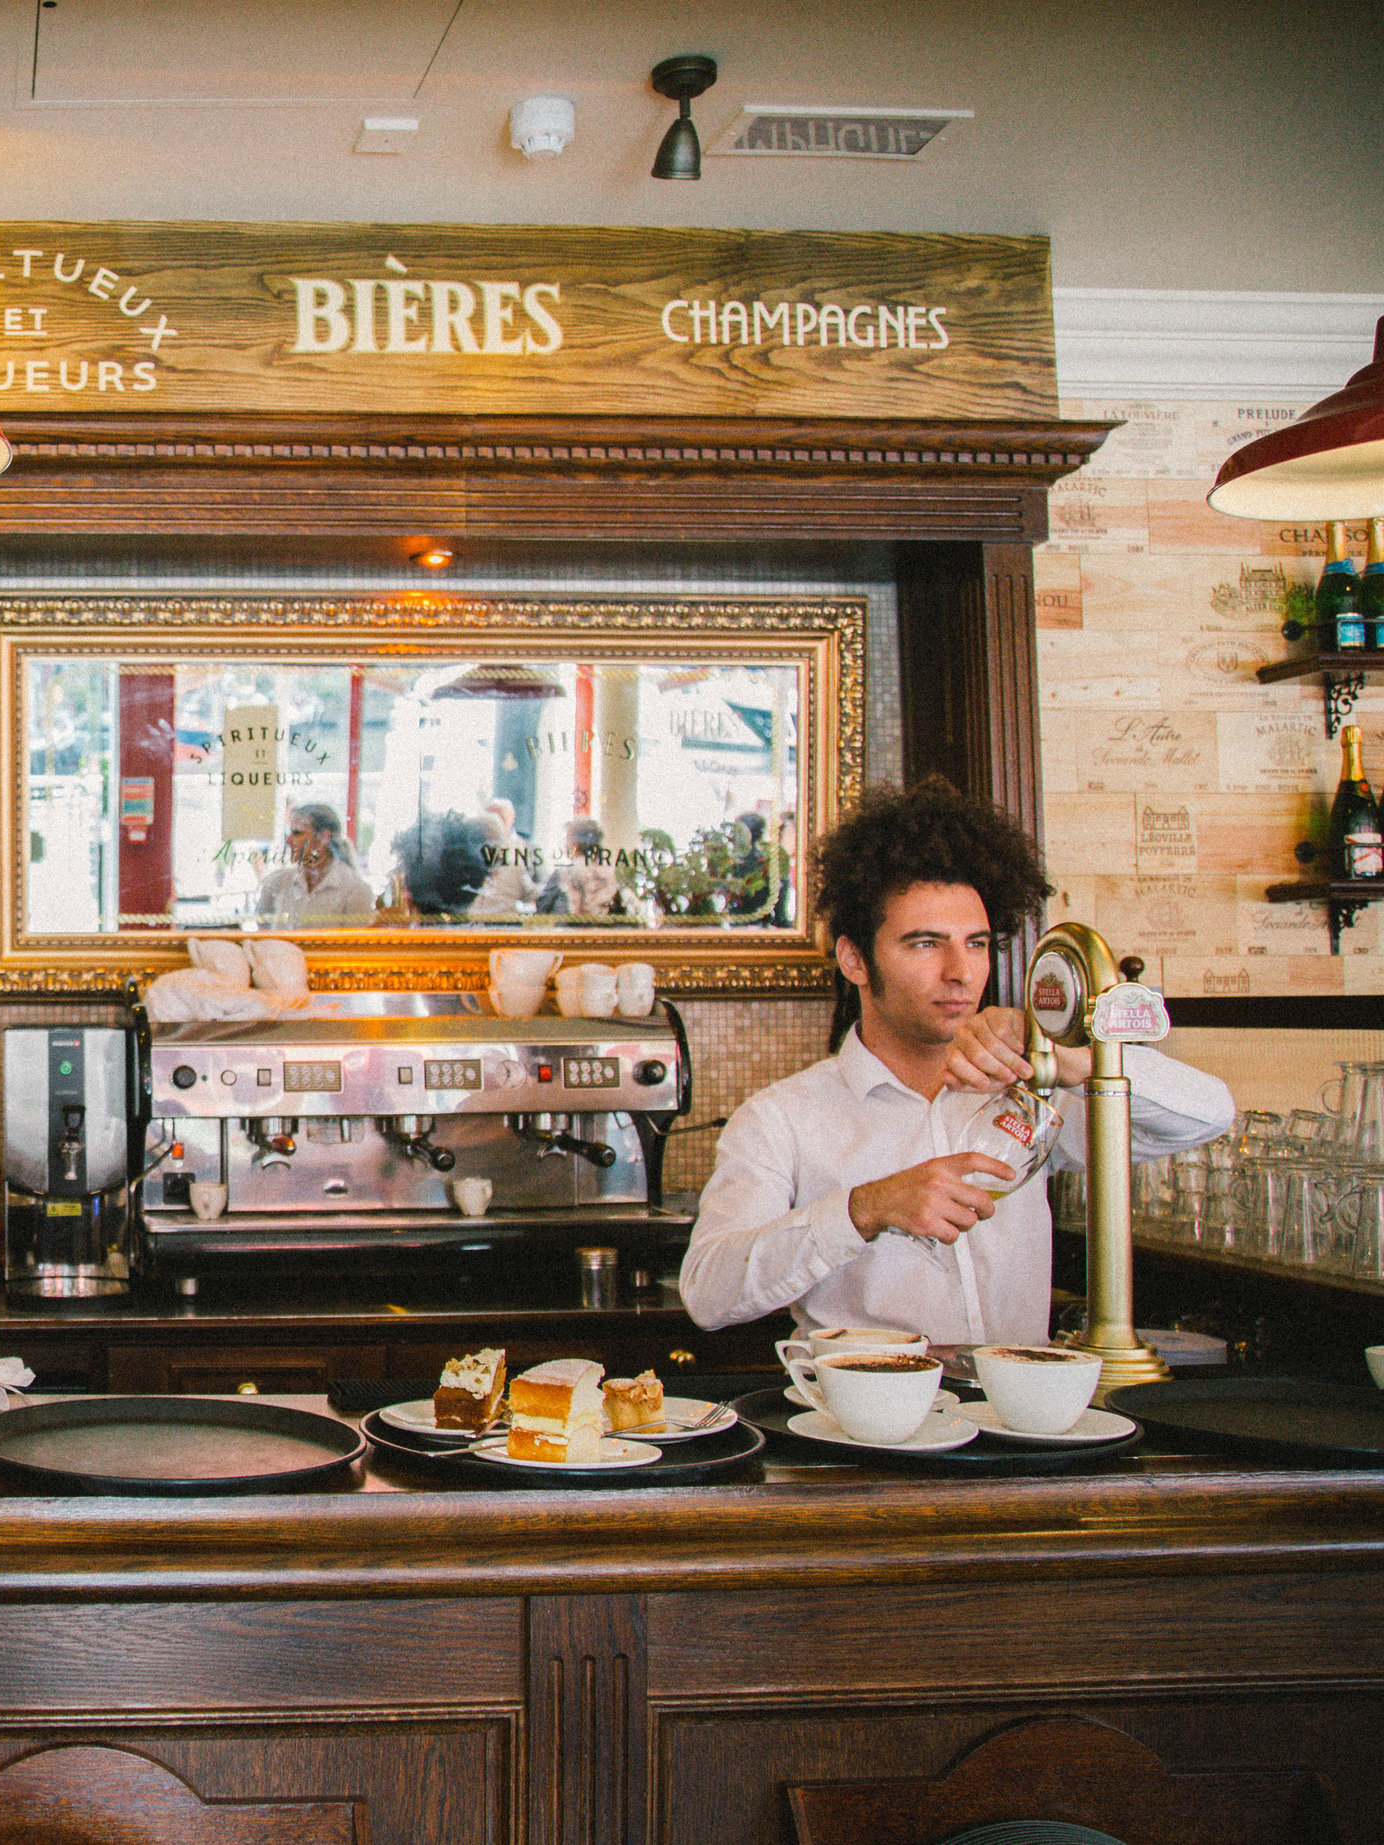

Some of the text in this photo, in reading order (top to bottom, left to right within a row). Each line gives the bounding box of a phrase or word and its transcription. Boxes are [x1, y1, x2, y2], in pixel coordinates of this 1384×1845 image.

[290, 255, 563, 355] BIÈRES
[4, 308, 48, 332] ET
[661, 300, 950, 350] CHAMPAGNES
[1279, 528, 1370, 544] CHASO
[191, 727, 331, 764] SPIRITUEUX
[208, 772, 314, 786] LIQUEURS
[481, 845, 545, 868] VINS
[1039, 988, 1060, 997] STELLA
[1039, 997, 1061, 1006] ARTOIS
[1000, 1120, 1028, 1142] ARTOIS
[1005, 1115, 1031, 1137] STELLA
